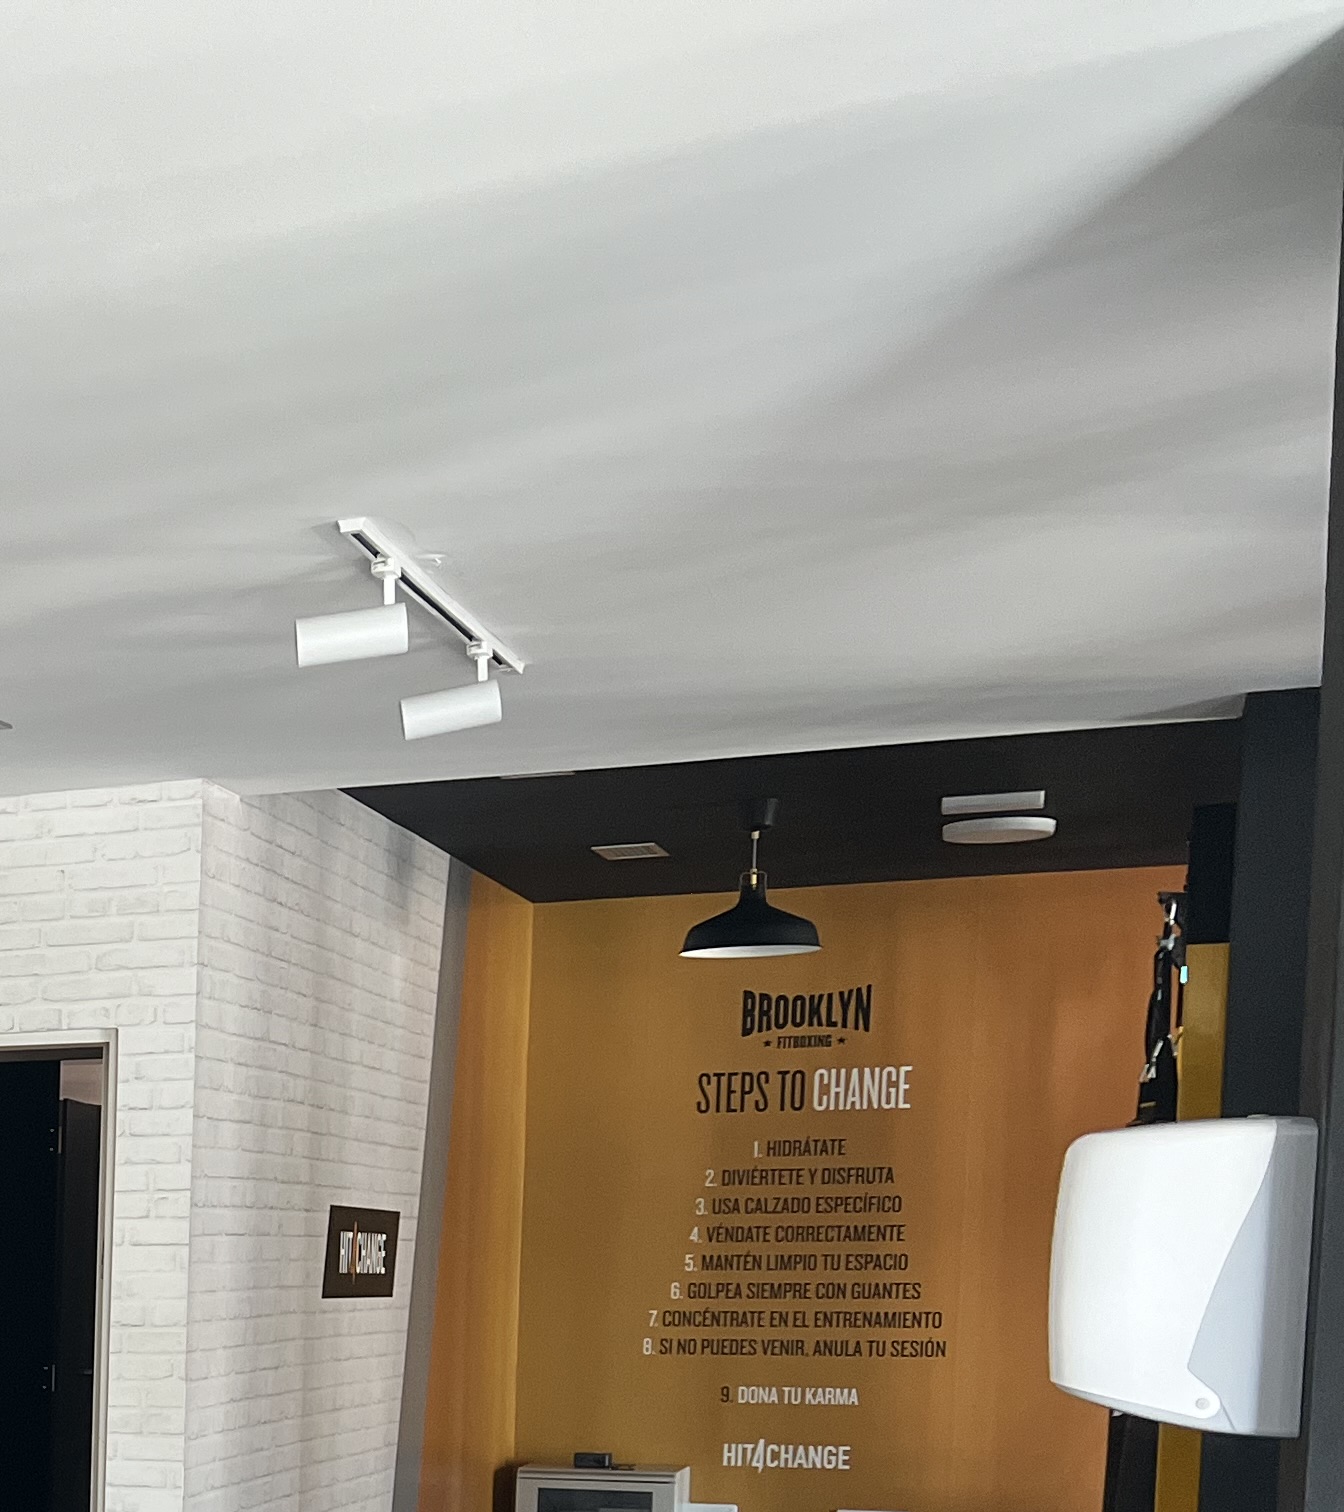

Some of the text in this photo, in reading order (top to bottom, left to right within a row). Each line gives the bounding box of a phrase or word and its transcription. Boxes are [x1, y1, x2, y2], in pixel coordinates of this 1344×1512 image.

[741, 983, 873, 1037] BROOKLYN
[776, 1034, 833, 1049] FITBOXING
[696, 1065, 913, 1114] STEPS TO CHANGE
[766, 1136, 847, 1157] HIDRÁTATE
[721, 1165, 805, 1187] DIVIÉRTETE
[808, 1168, 818, 1185] Y
[821, 1167, 895, 1185] DISFRUTA
[712, 1198, 741, 1214] USA
[744, 1197, 811, 1214] CALZADO
[815, 1192, 902, 1213] ESPECÍFICO
[706, 1222, 772, 1243] VÉNDATE
[775, 1224, 906, 1243] CORRECTAMENTE
[701, 1250, 762, 1271] MANTÉN
[766, 1254, 818, 1271] LIMPIO
[821, 1254, 841, 1271] TU
[845, 1253, 909, 1271] ESPACIO
[687, 1282, 743, 1299] GOLPEA
[746, 1282, 812, 1299] SIEMPRE
[815, 1282, 847, 1299] CON
[851, 1282, 922, 1299] GUANTES
[662, 1307, 765, 1328] CONCÉNTRATE
[769, 1311, 789, 1328] EN
[792, 1311, 810, 1328] EL
[814, 1311, 943, 1329] ENTRENAMIENTO
[659, 1338, 673, 1355] SI
[676, 1338, 697, 1355] NO
[701, 1338, 757, 1356] PUEDES
[813, 1340, 862, 1357] ANULA
[866, 1340, 886, 1357] TU
[890, 1337, 947, 1358] SESIÓN
[737, 1386, 779, 1404] DONA
[781, 1387, 802, 1405] TU
[805, 1387, 859, 1405] KARMA
[722, 1438, 851, 1473] HIT4CHANGE
